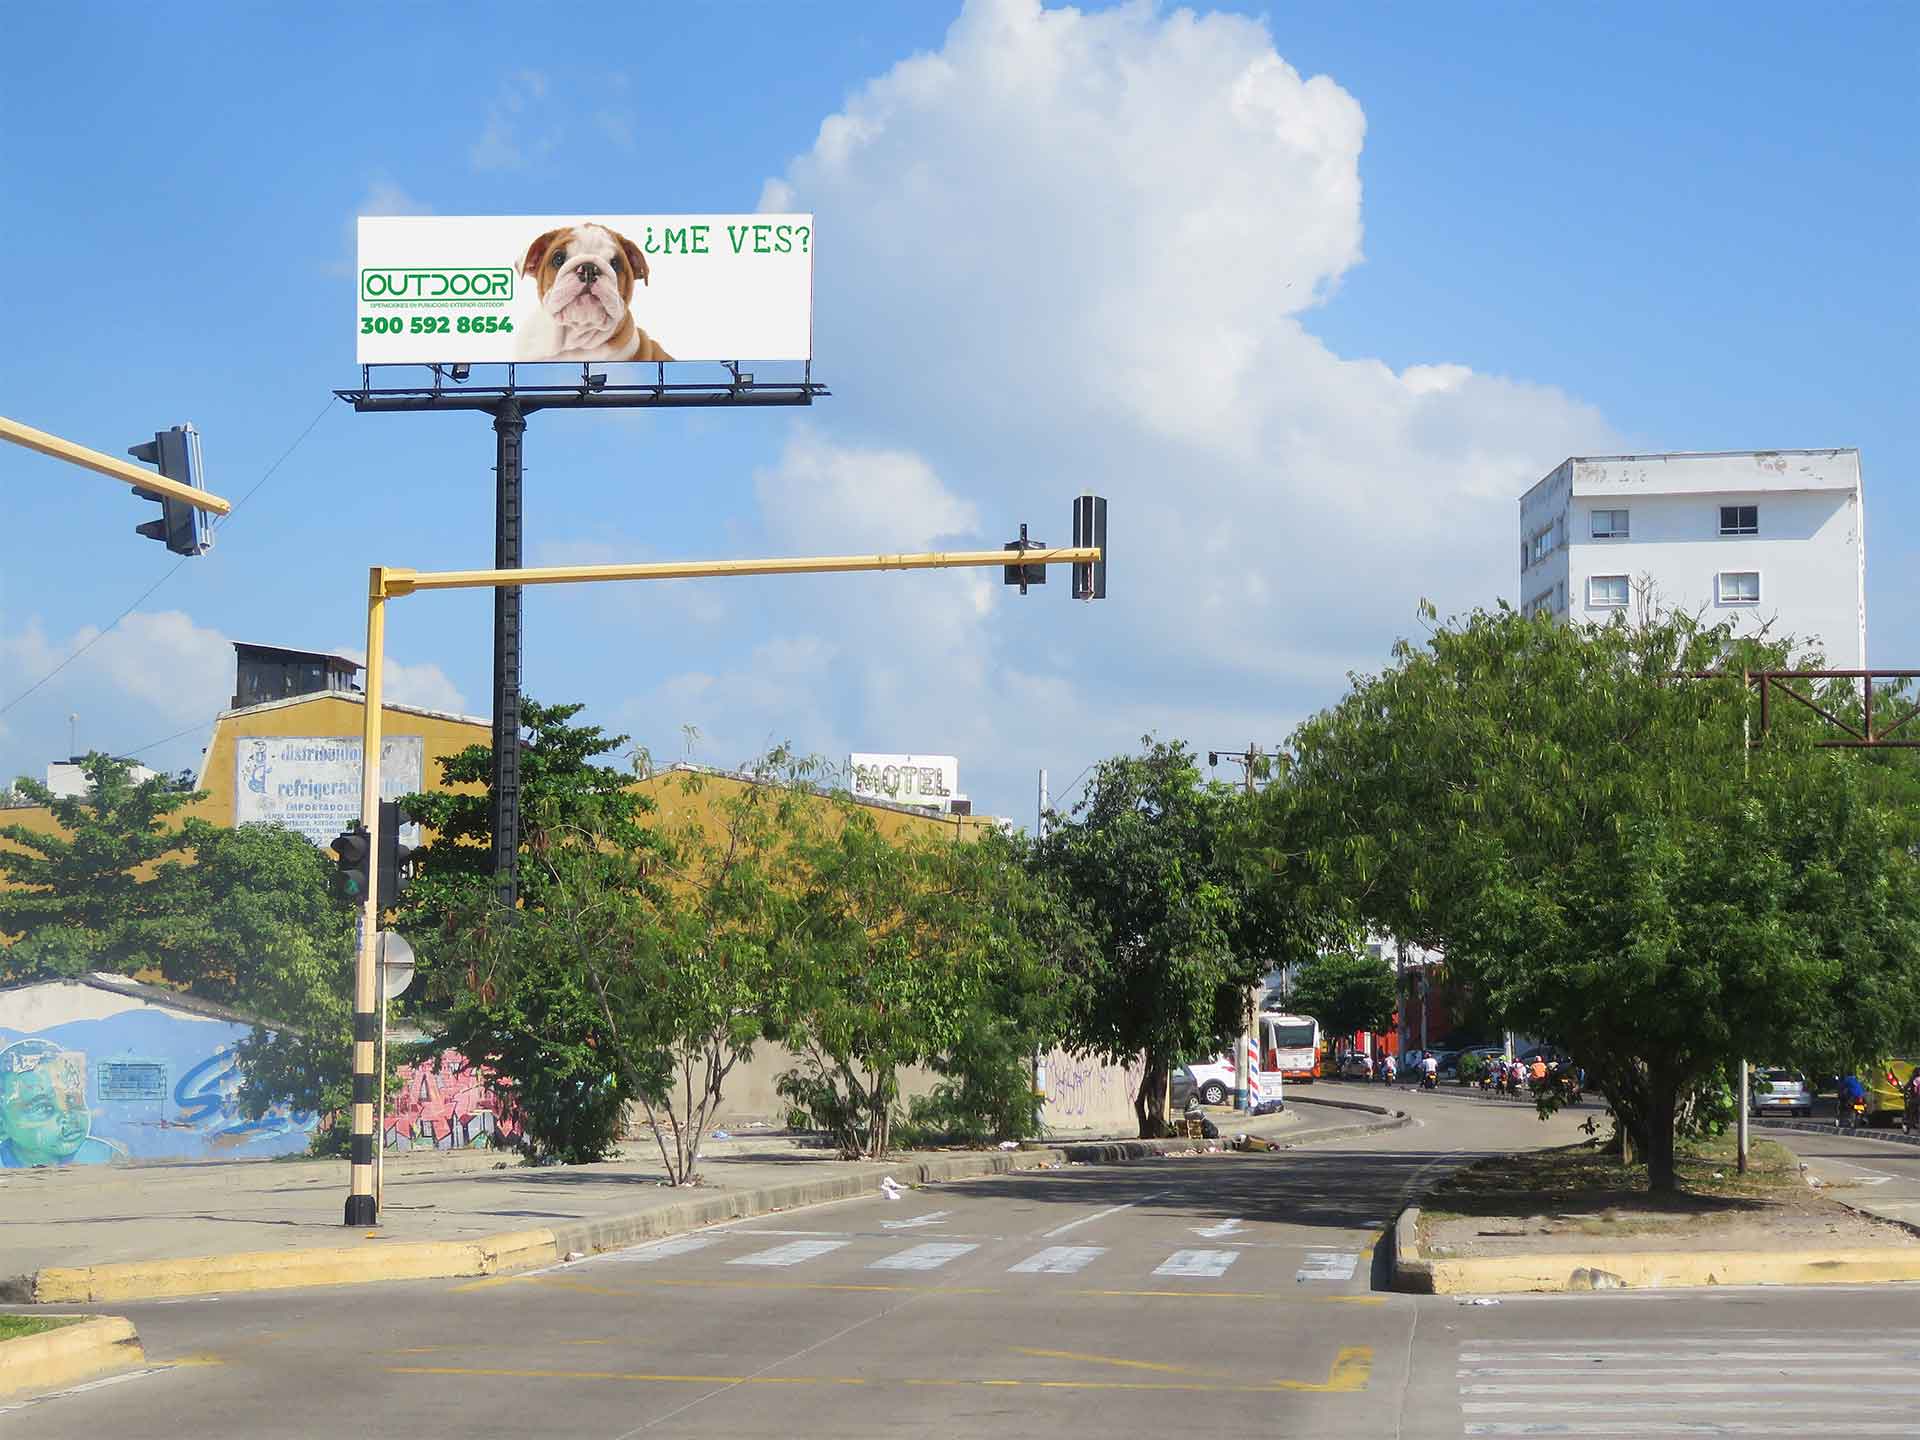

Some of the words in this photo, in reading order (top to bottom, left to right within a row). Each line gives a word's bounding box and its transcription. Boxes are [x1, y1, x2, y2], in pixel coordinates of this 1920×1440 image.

[645, 225, 710, 254] ¿ME
[727, 225, 810, 254] VES?
[366, 273, 509, 296] OUTDOOR
[361, 316, 403, 334] 300
[410, 316, 450, 334] 592
[456, 316, 513, 334] 8654
[855, 763, 951, 797] MOTEL
